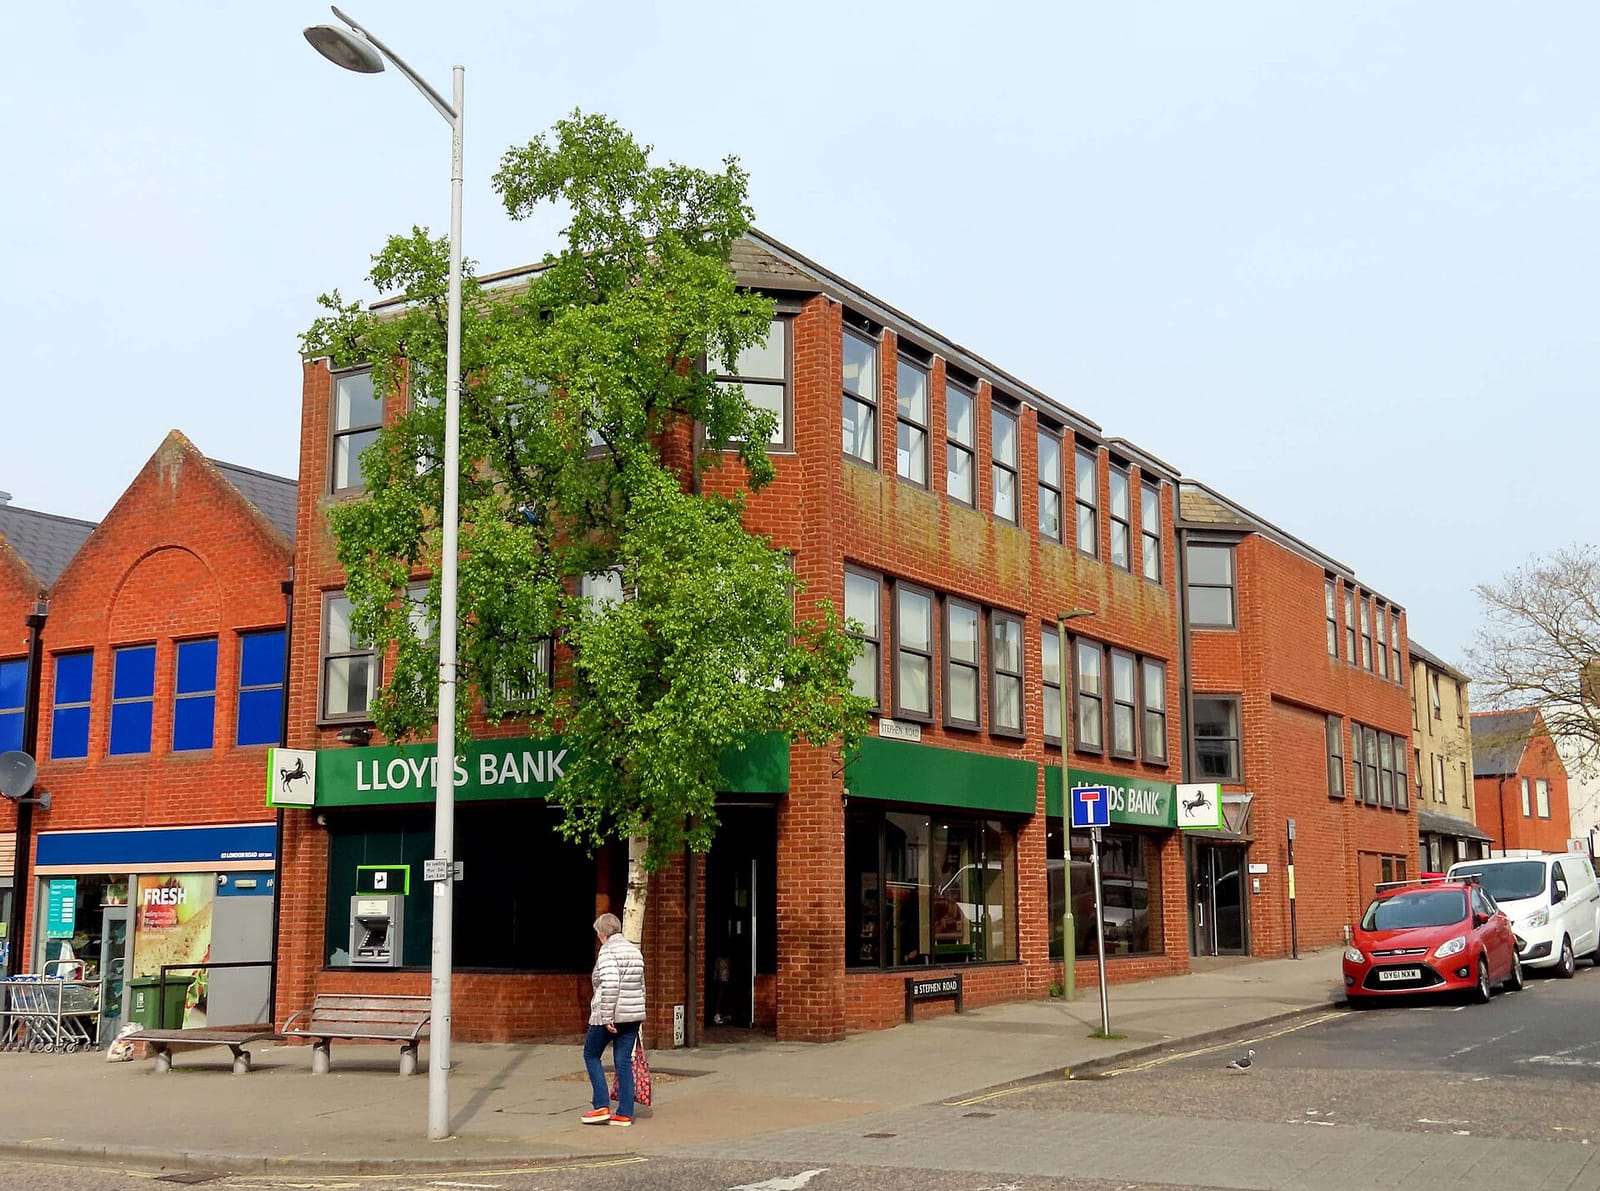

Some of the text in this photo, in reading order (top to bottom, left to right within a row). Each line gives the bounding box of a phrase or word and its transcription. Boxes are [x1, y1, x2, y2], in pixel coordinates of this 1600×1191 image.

[881, 722, 919, 738] STEPHEN ROAD
[480, 749, 568, 786] BANK
[1128, 787, 1160, 816] BANK
[144, 887, 187, 905] FRESH
[919, 980, 958, 994] STEPHEN ROAD
[675, 1031, 683, 1040] SV
